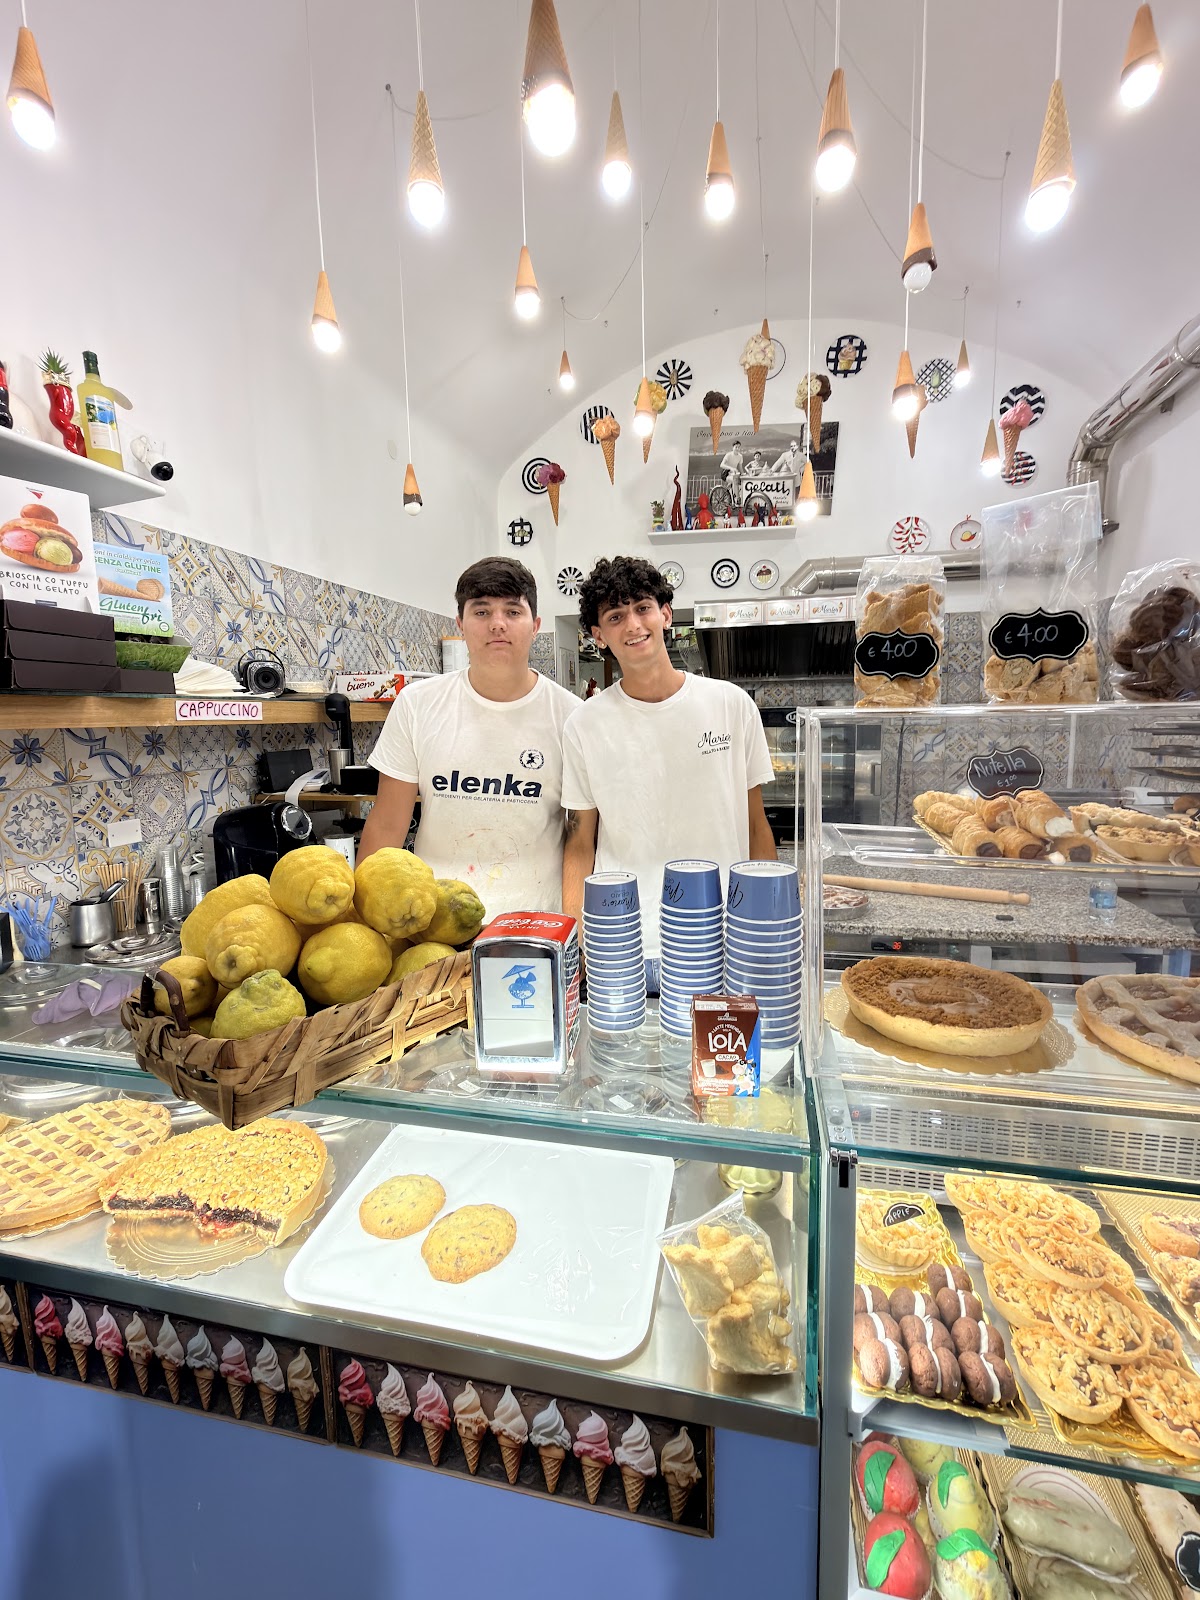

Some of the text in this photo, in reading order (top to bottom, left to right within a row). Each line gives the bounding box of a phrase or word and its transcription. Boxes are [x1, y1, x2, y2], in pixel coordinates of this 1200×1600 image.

[744, 481, 790, 496] Gelati
[124, 562, 162, 573] GLUTINE
[0, 571, 89, 589] BRIOSCIA CO TUPPU
[9, 580, 29, 590] CON
[45, 585, 80, 595] GELATO
[1004, 623, 1059, 648] € 4.00
[868, 640, 918, 660] € 4.00
[346, 682, 375, 692] bueno
[178, 701, 259, 718] CAPPUCCINO
[973, 755, 1027, 778] Nutella
[432, 770, 542, 798] elenka
[708, 1032, 747, 1052] LOLA
